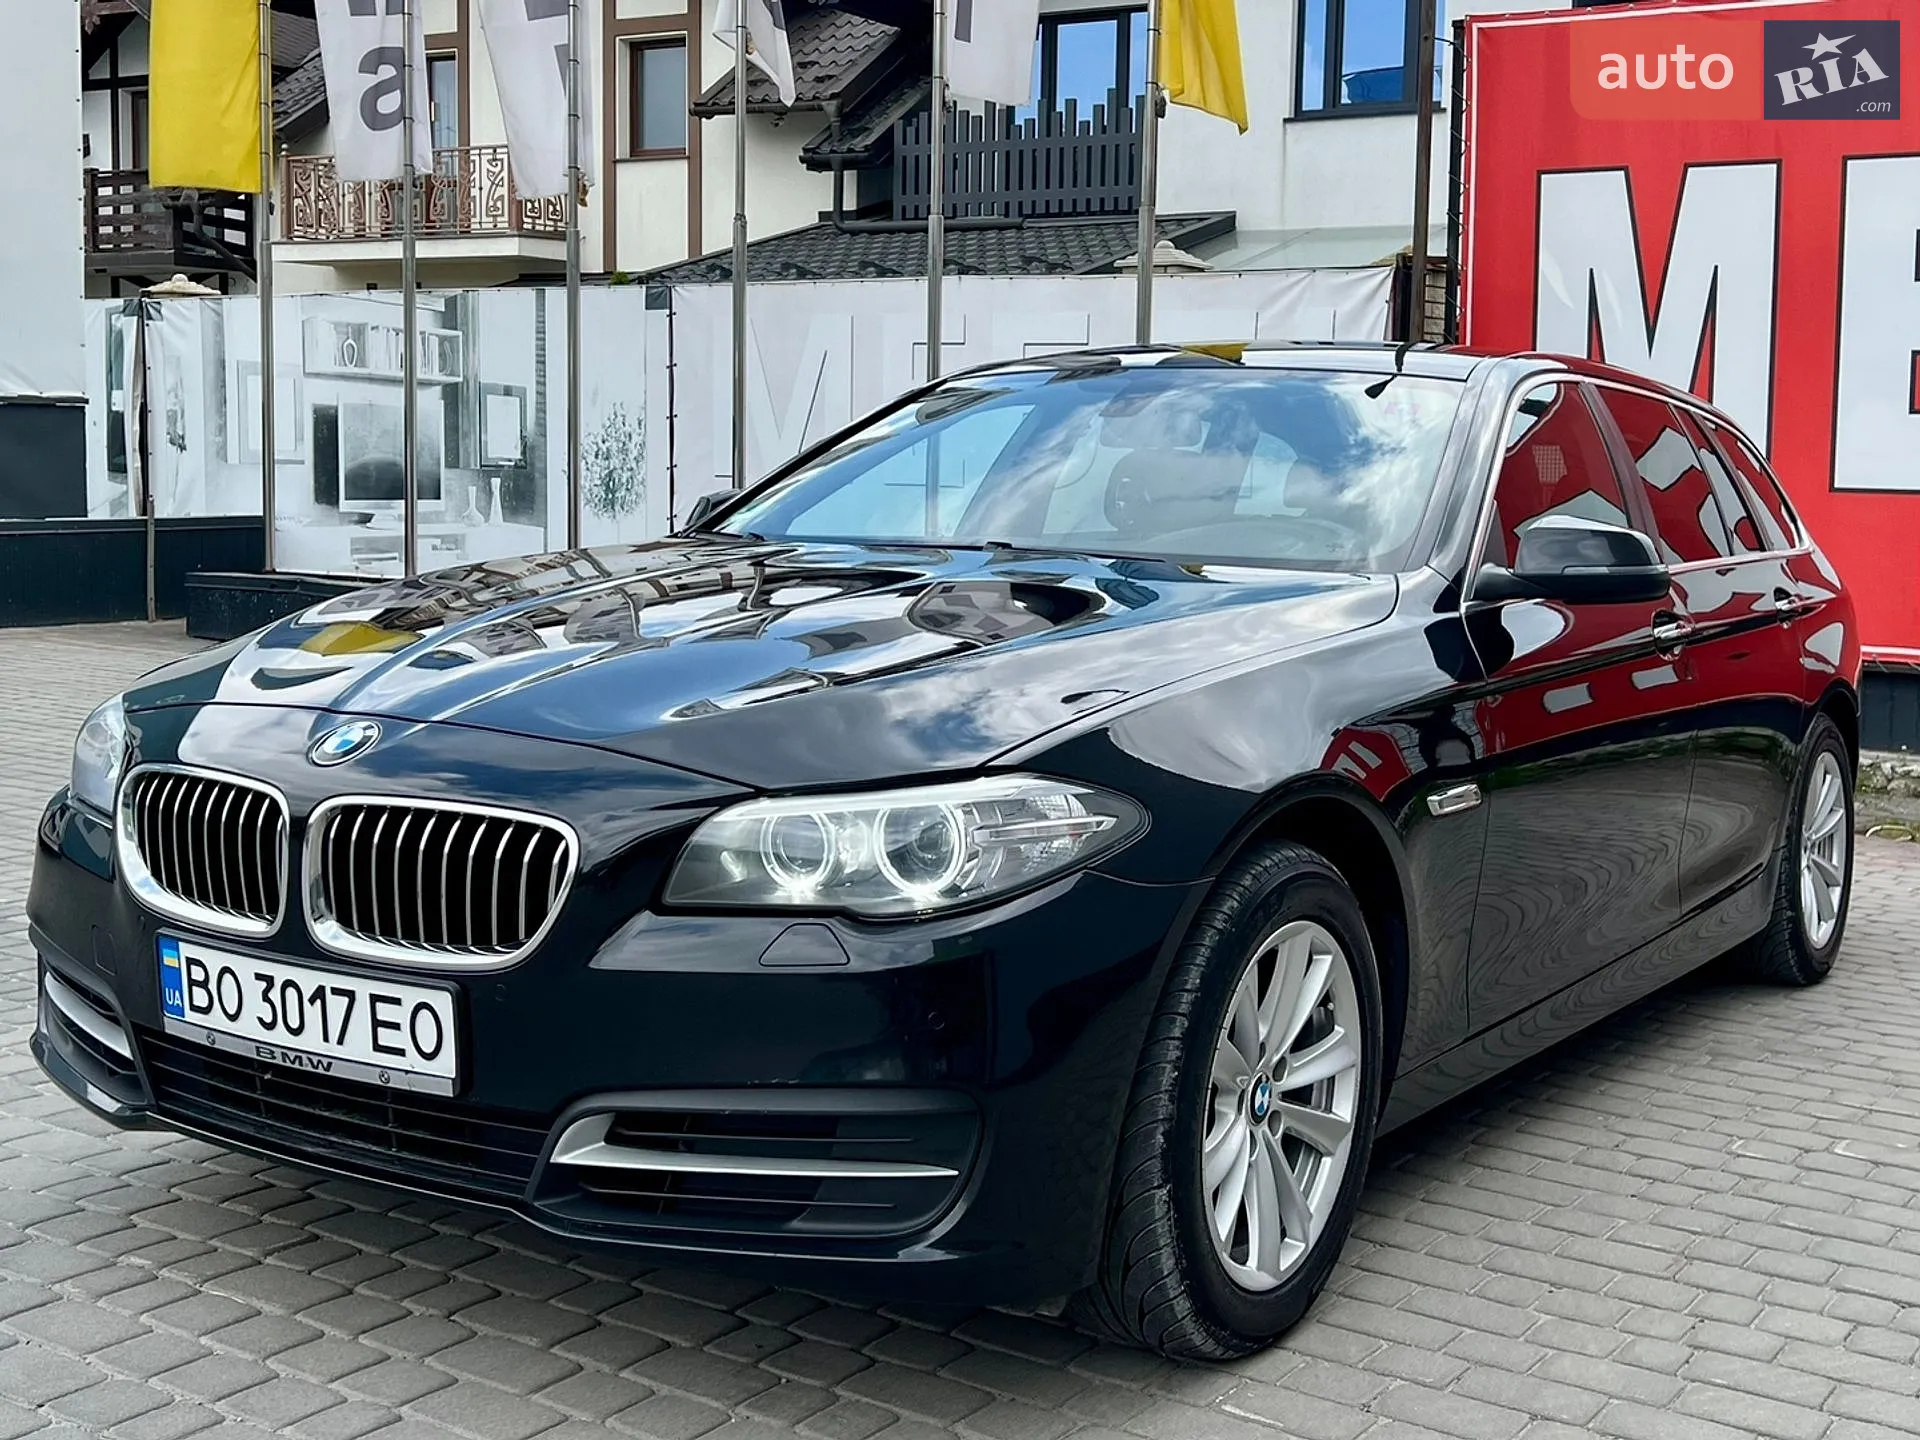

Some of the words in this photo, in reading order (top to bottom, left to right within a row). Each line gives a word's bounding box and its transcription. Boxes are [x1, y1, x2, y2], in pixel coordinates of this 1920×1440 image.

[165, 987, 183, 1008] UA
[185, 956, 243, 1022] BO
[253, 972, 356, 1046] 3017
[369, 993, 443, 1061] EO
[255, 1045, 333, 1073] BMW
